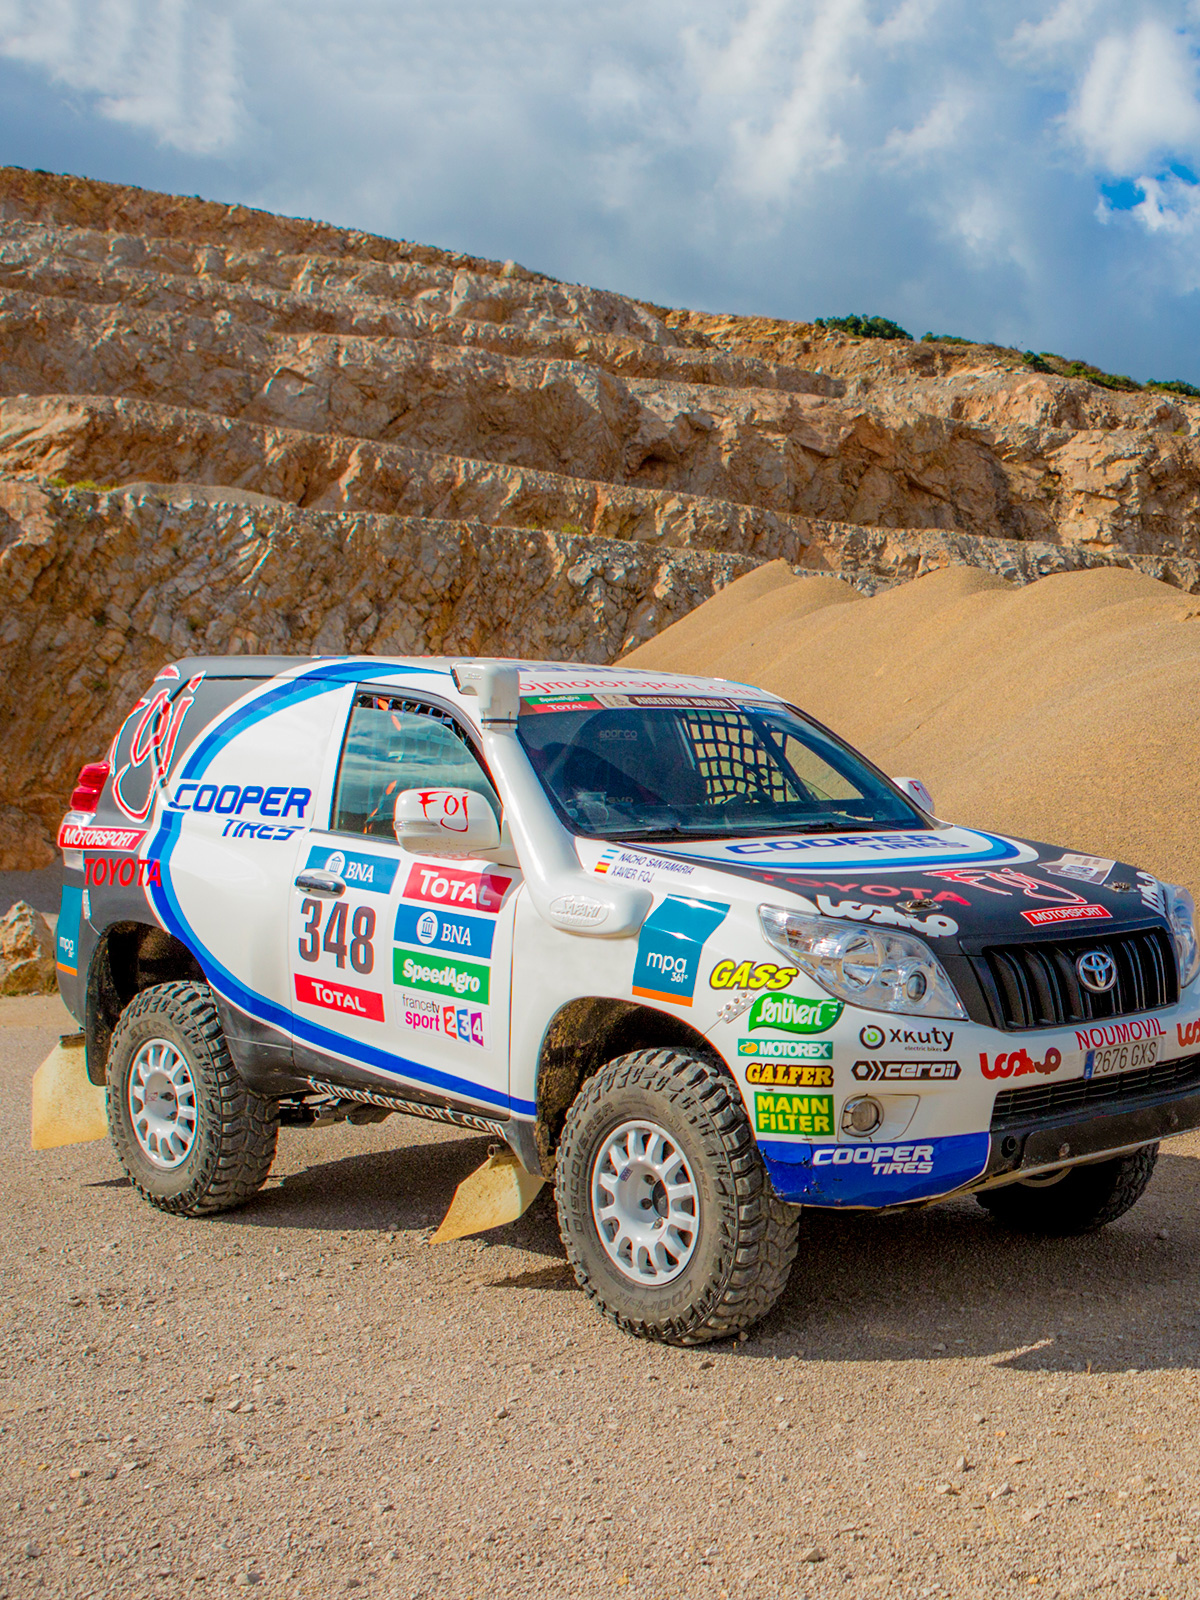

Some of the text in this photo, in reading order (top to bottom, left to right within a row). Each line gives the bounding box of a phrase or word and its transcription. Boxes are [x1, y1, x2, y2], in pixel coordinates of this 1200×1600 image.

[519, 678, 761, 699] ojmotorsport.com
[547, 703, 588, 711] TOTAL
[599, 729, 639, 739] sparco
[168, 783, 312, 819] COOPER
[63, 827, 139, 848] MOTORSPORT
[222, 818, 306, 841] TIRES
[724, 833, 944, 855] COOPER
[858, 839, 970, 851] TIRES
[84, 857, 162, 888] TOYOTA
[344, 860, 375, 883] BNA
[611, 865, 655, 884] XAVIER FOJ
[618, 852, 695, 875] NACHO SANTAMARIA
[419, 869, 492, 906] TOTAL
[750, 871, 972, 907] TOYOTA
[1032, 905, 1105, 923] MOTORSPORT
[298, 897, 378, 975] 348
[441, 925, 472, 947] BNA
[402, 958, 480, 994] SpeedAgro
[709, 958, 800, 991] GASS
[311, 981, 367, 1013] TOTAL
[402, 993, 440, 1014] francetv
[405, 1010, 441, 1032] sport
[755, 996, 823, 1027] Santiveri
[889, 1026, 955, 1052] xkuty
[1075, 1017, 1167, 1050] NOUMOVIL
[758, 1040, 830, 1058] MOTOREX
[1094, 1041, 1158, 1075] 2676 GXS
[746, 1063, 834, 1088] GALFER
[883, 1063, 957, 1078] ceroil
[757, 1096, 829, 1115] MANN
[757, 1113, 830, 1133] FILTER
[812, 1144, 935, 1167] COOPER
[871, 1161, 935, 1176] TIRES
